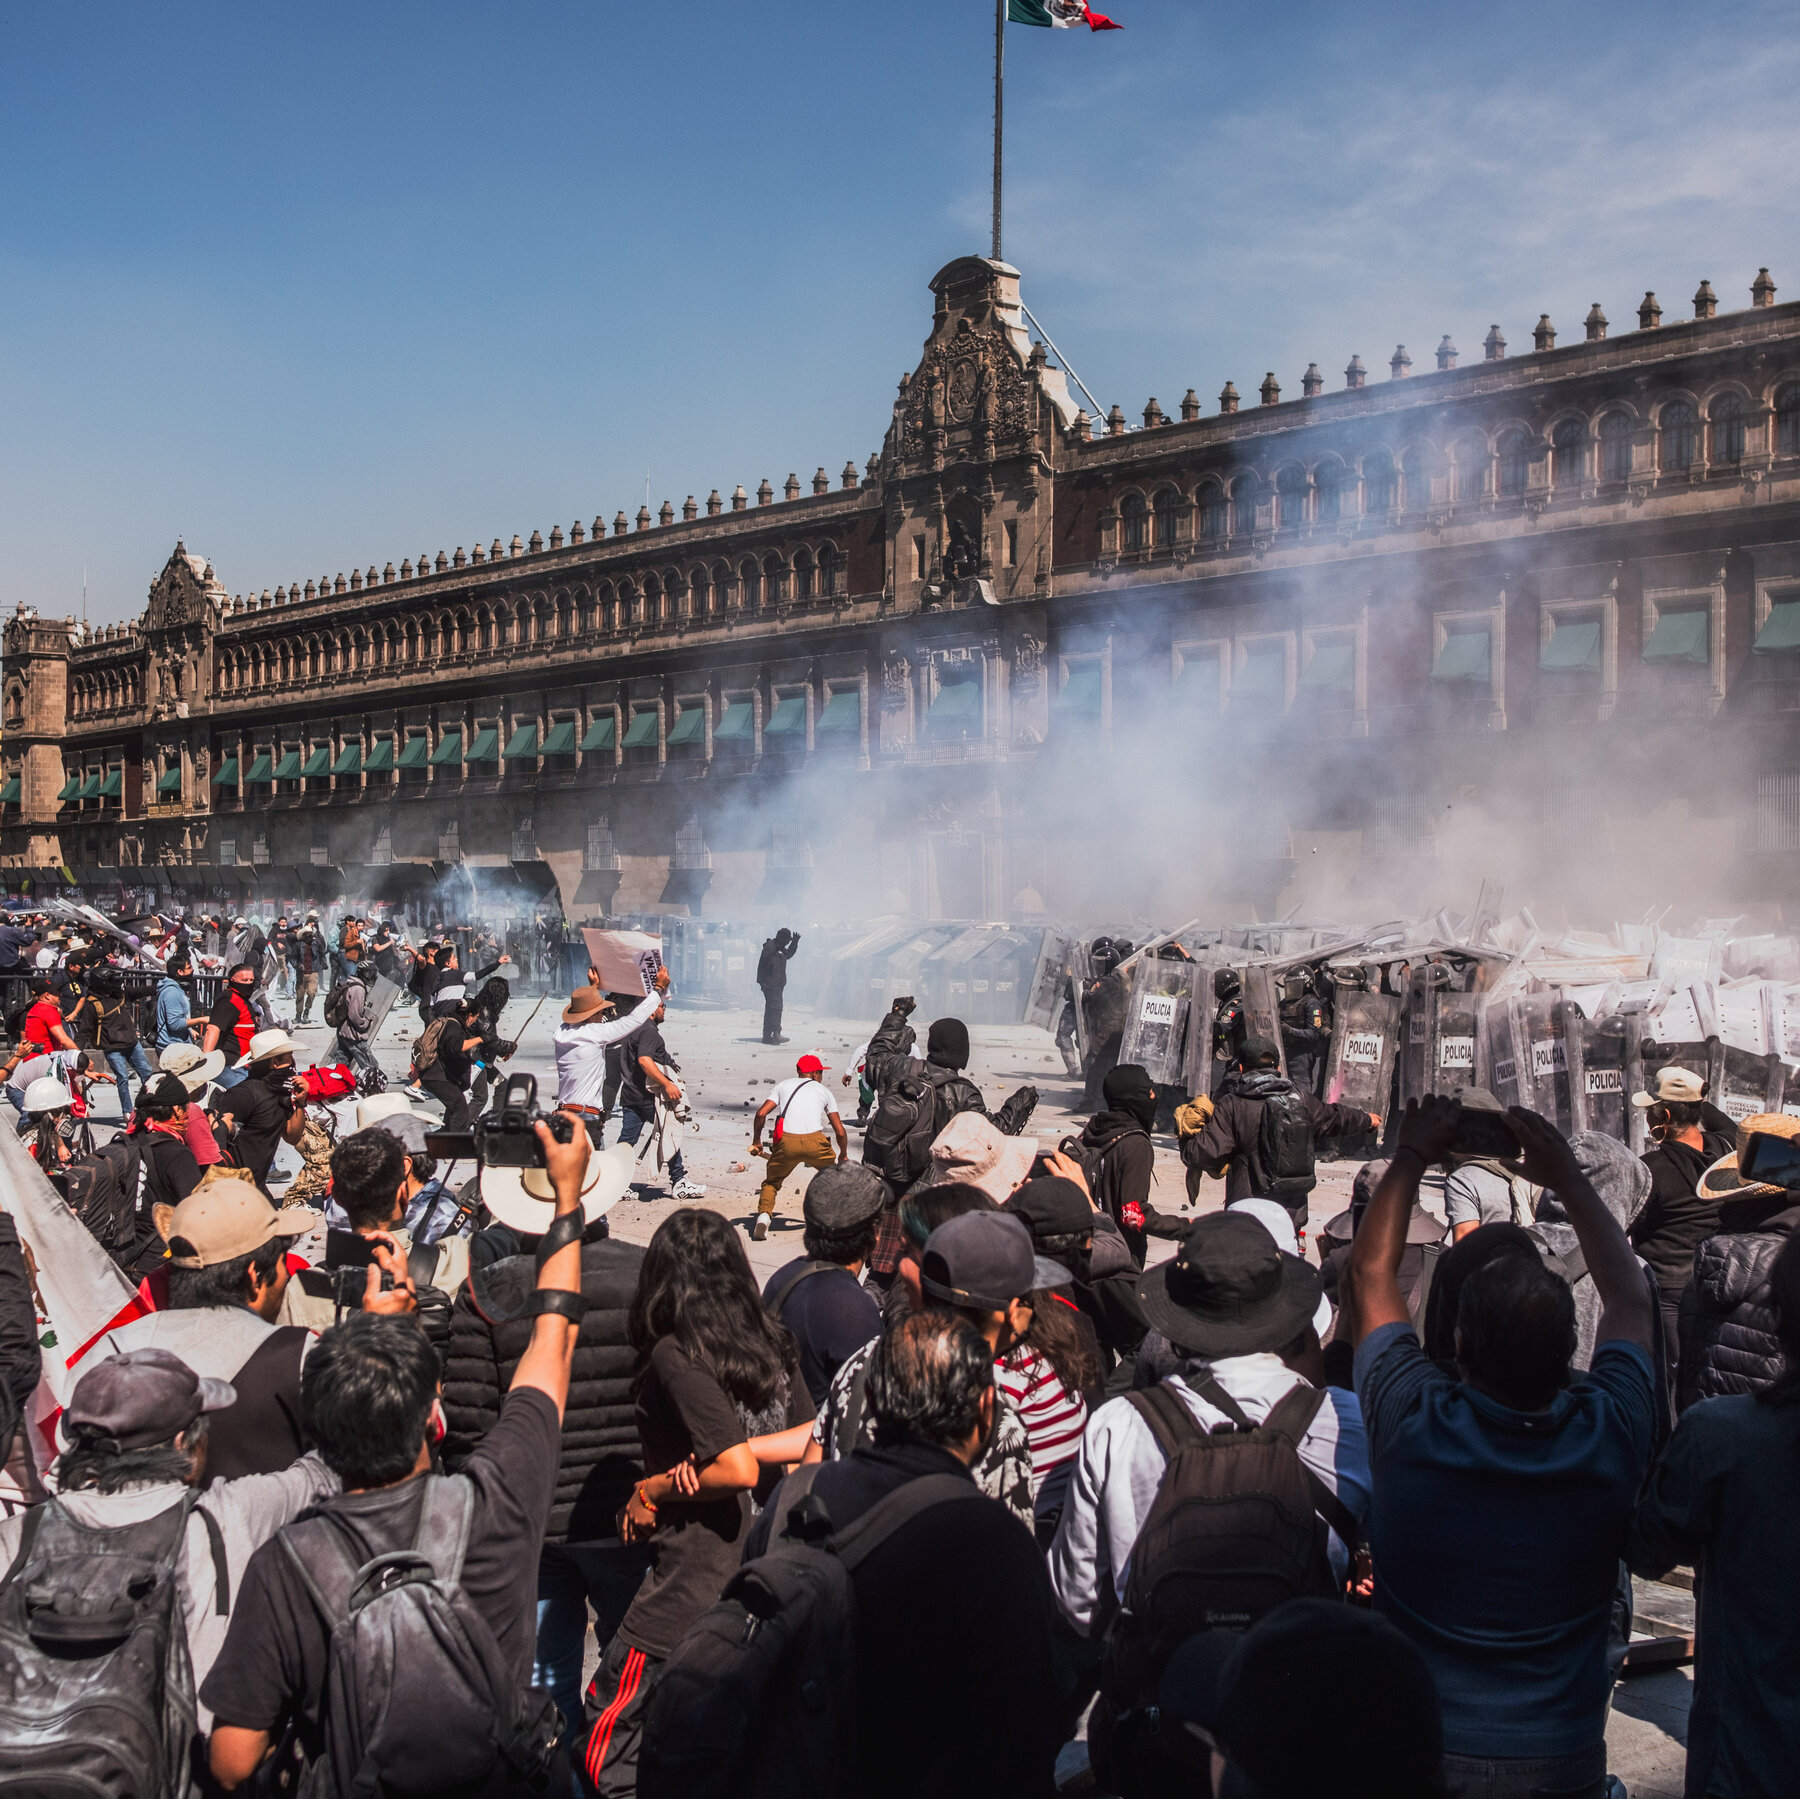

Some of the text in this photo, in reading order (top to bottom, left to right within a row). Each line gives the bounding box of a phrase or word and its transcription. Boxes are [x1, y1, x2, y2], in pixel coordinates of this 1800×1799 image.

[644, 956, 658, 991] ORENA
[1145, 1001, 1171, 1017] POLICIA
[1348, 1040, 1378, 1056] POLICIA
[1444, 1045, 1473, 1060] POLICIA
[1536, 1046, 1565, 1066] POLICIA
[1589, 1072, 1623, 1090] POLICIA
